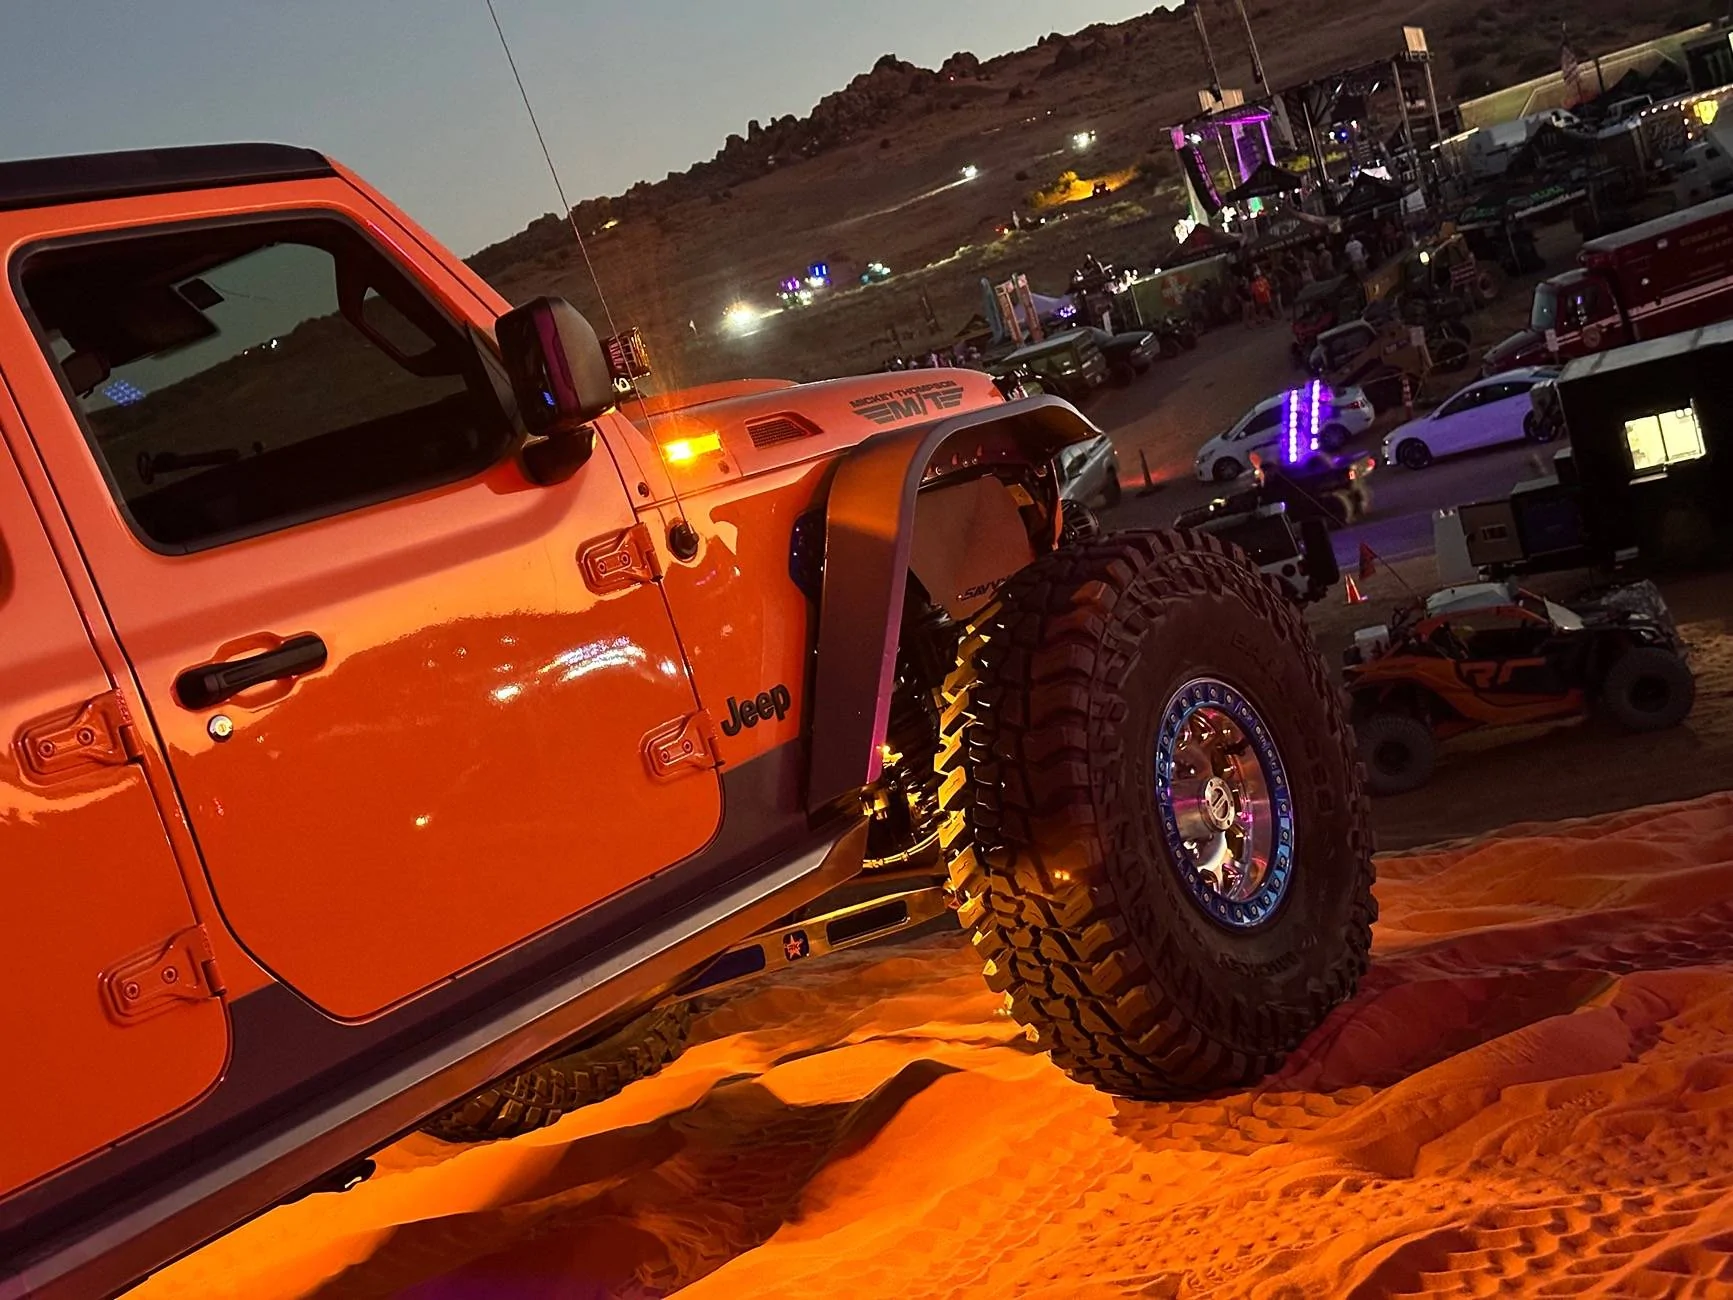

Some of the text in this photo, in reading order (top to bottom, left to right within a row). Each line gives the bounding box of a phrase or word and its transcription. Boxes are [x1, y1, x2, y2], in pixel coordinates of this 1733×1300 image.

[849, 380, 957, 408] MICKEY THOMPSON
[721, 684, 791, 736] Jeep
